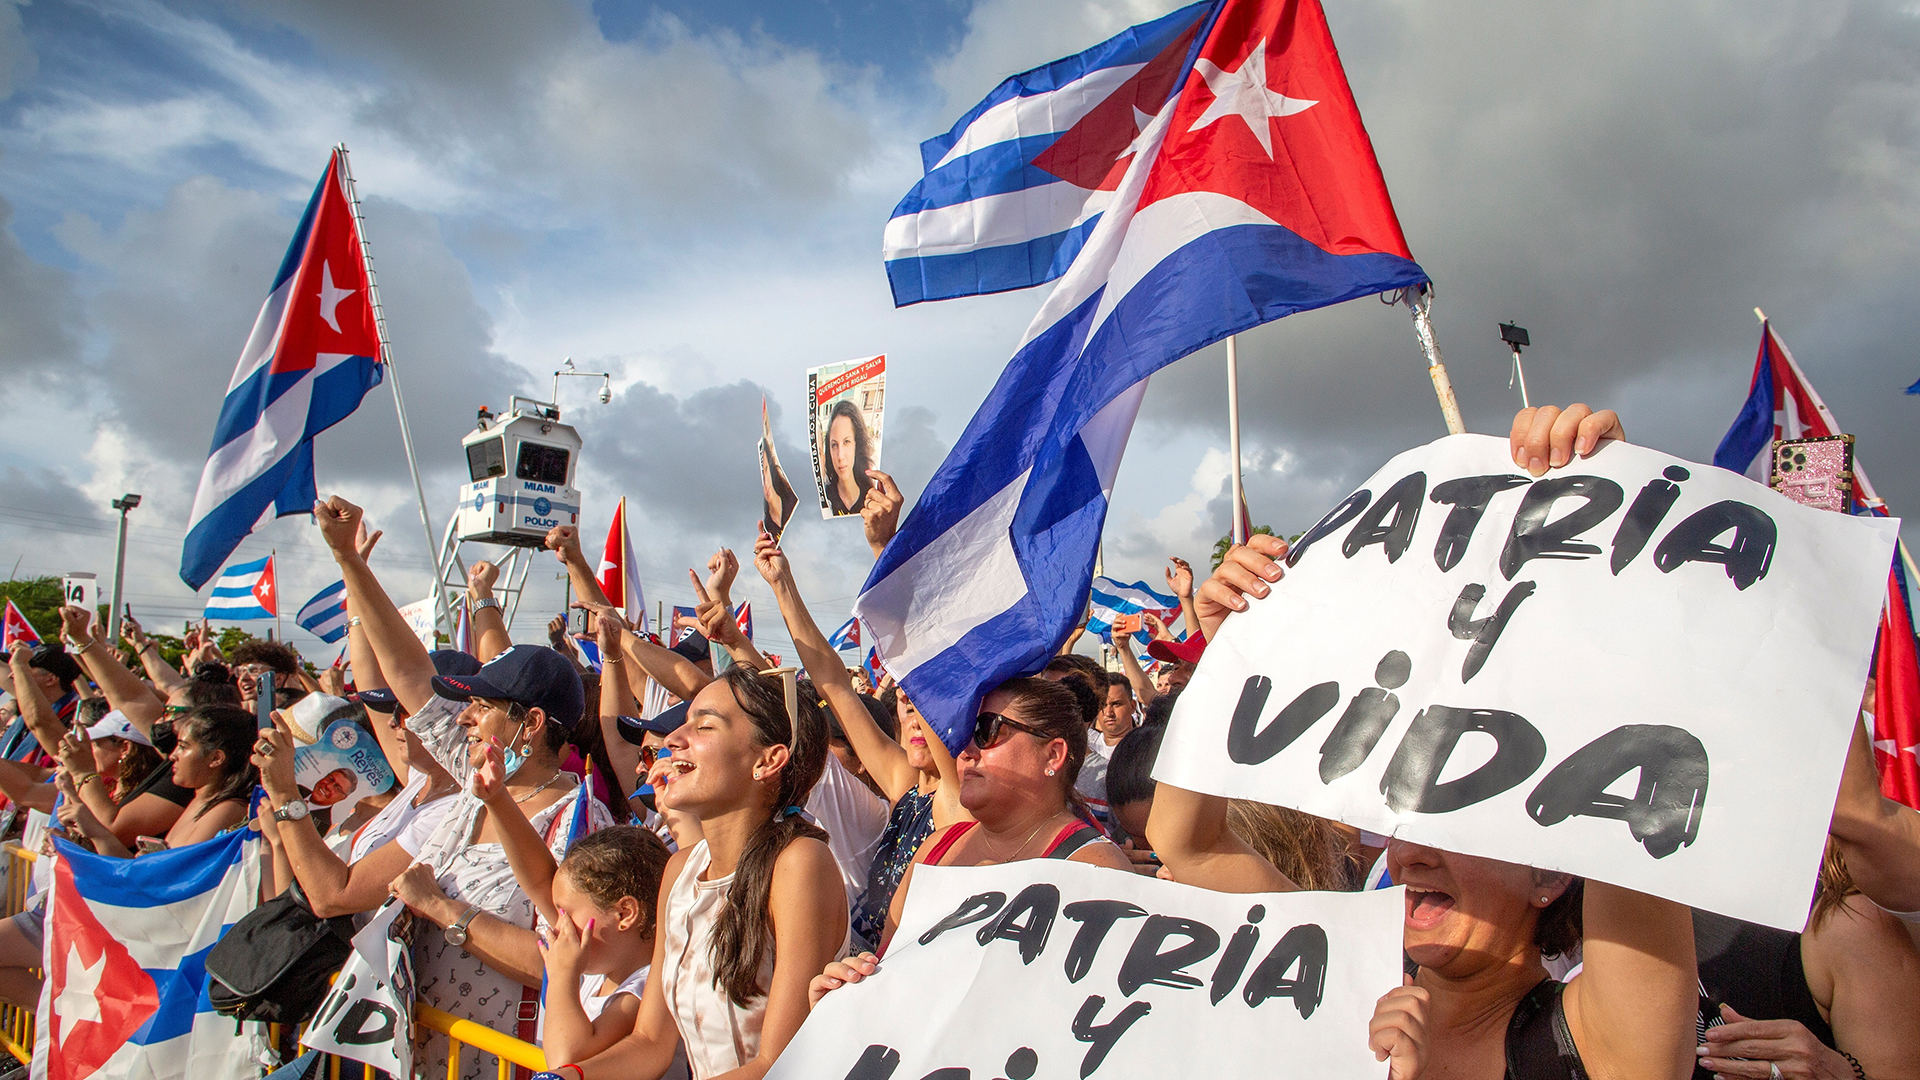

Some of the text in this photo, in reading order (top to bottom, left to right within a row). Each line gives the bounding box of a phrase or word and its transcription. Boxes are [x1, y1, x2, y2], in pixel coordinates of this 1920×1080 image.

[818, 375, 845, 396] QUEREMOS
[845, 368, 860, 380] SANA
[865, 358, 882, 371] SALVA
[836, 381, 850, 393] NEIFE
[850, 373, 868, 386] RIGAU
[811, 442, 820, 473] CUBA
[473, 480, 489, 491] MIAMI
[524, 481, 556, 494] MIAMI
[524, 516, 559, 528] POLICE
[1447, 580, 1536, 684] Y
[443, 676, 471, 691] CUBA
[350, 749, 381, 787] Reyes
[364, 754, 384, 780] Manolo
